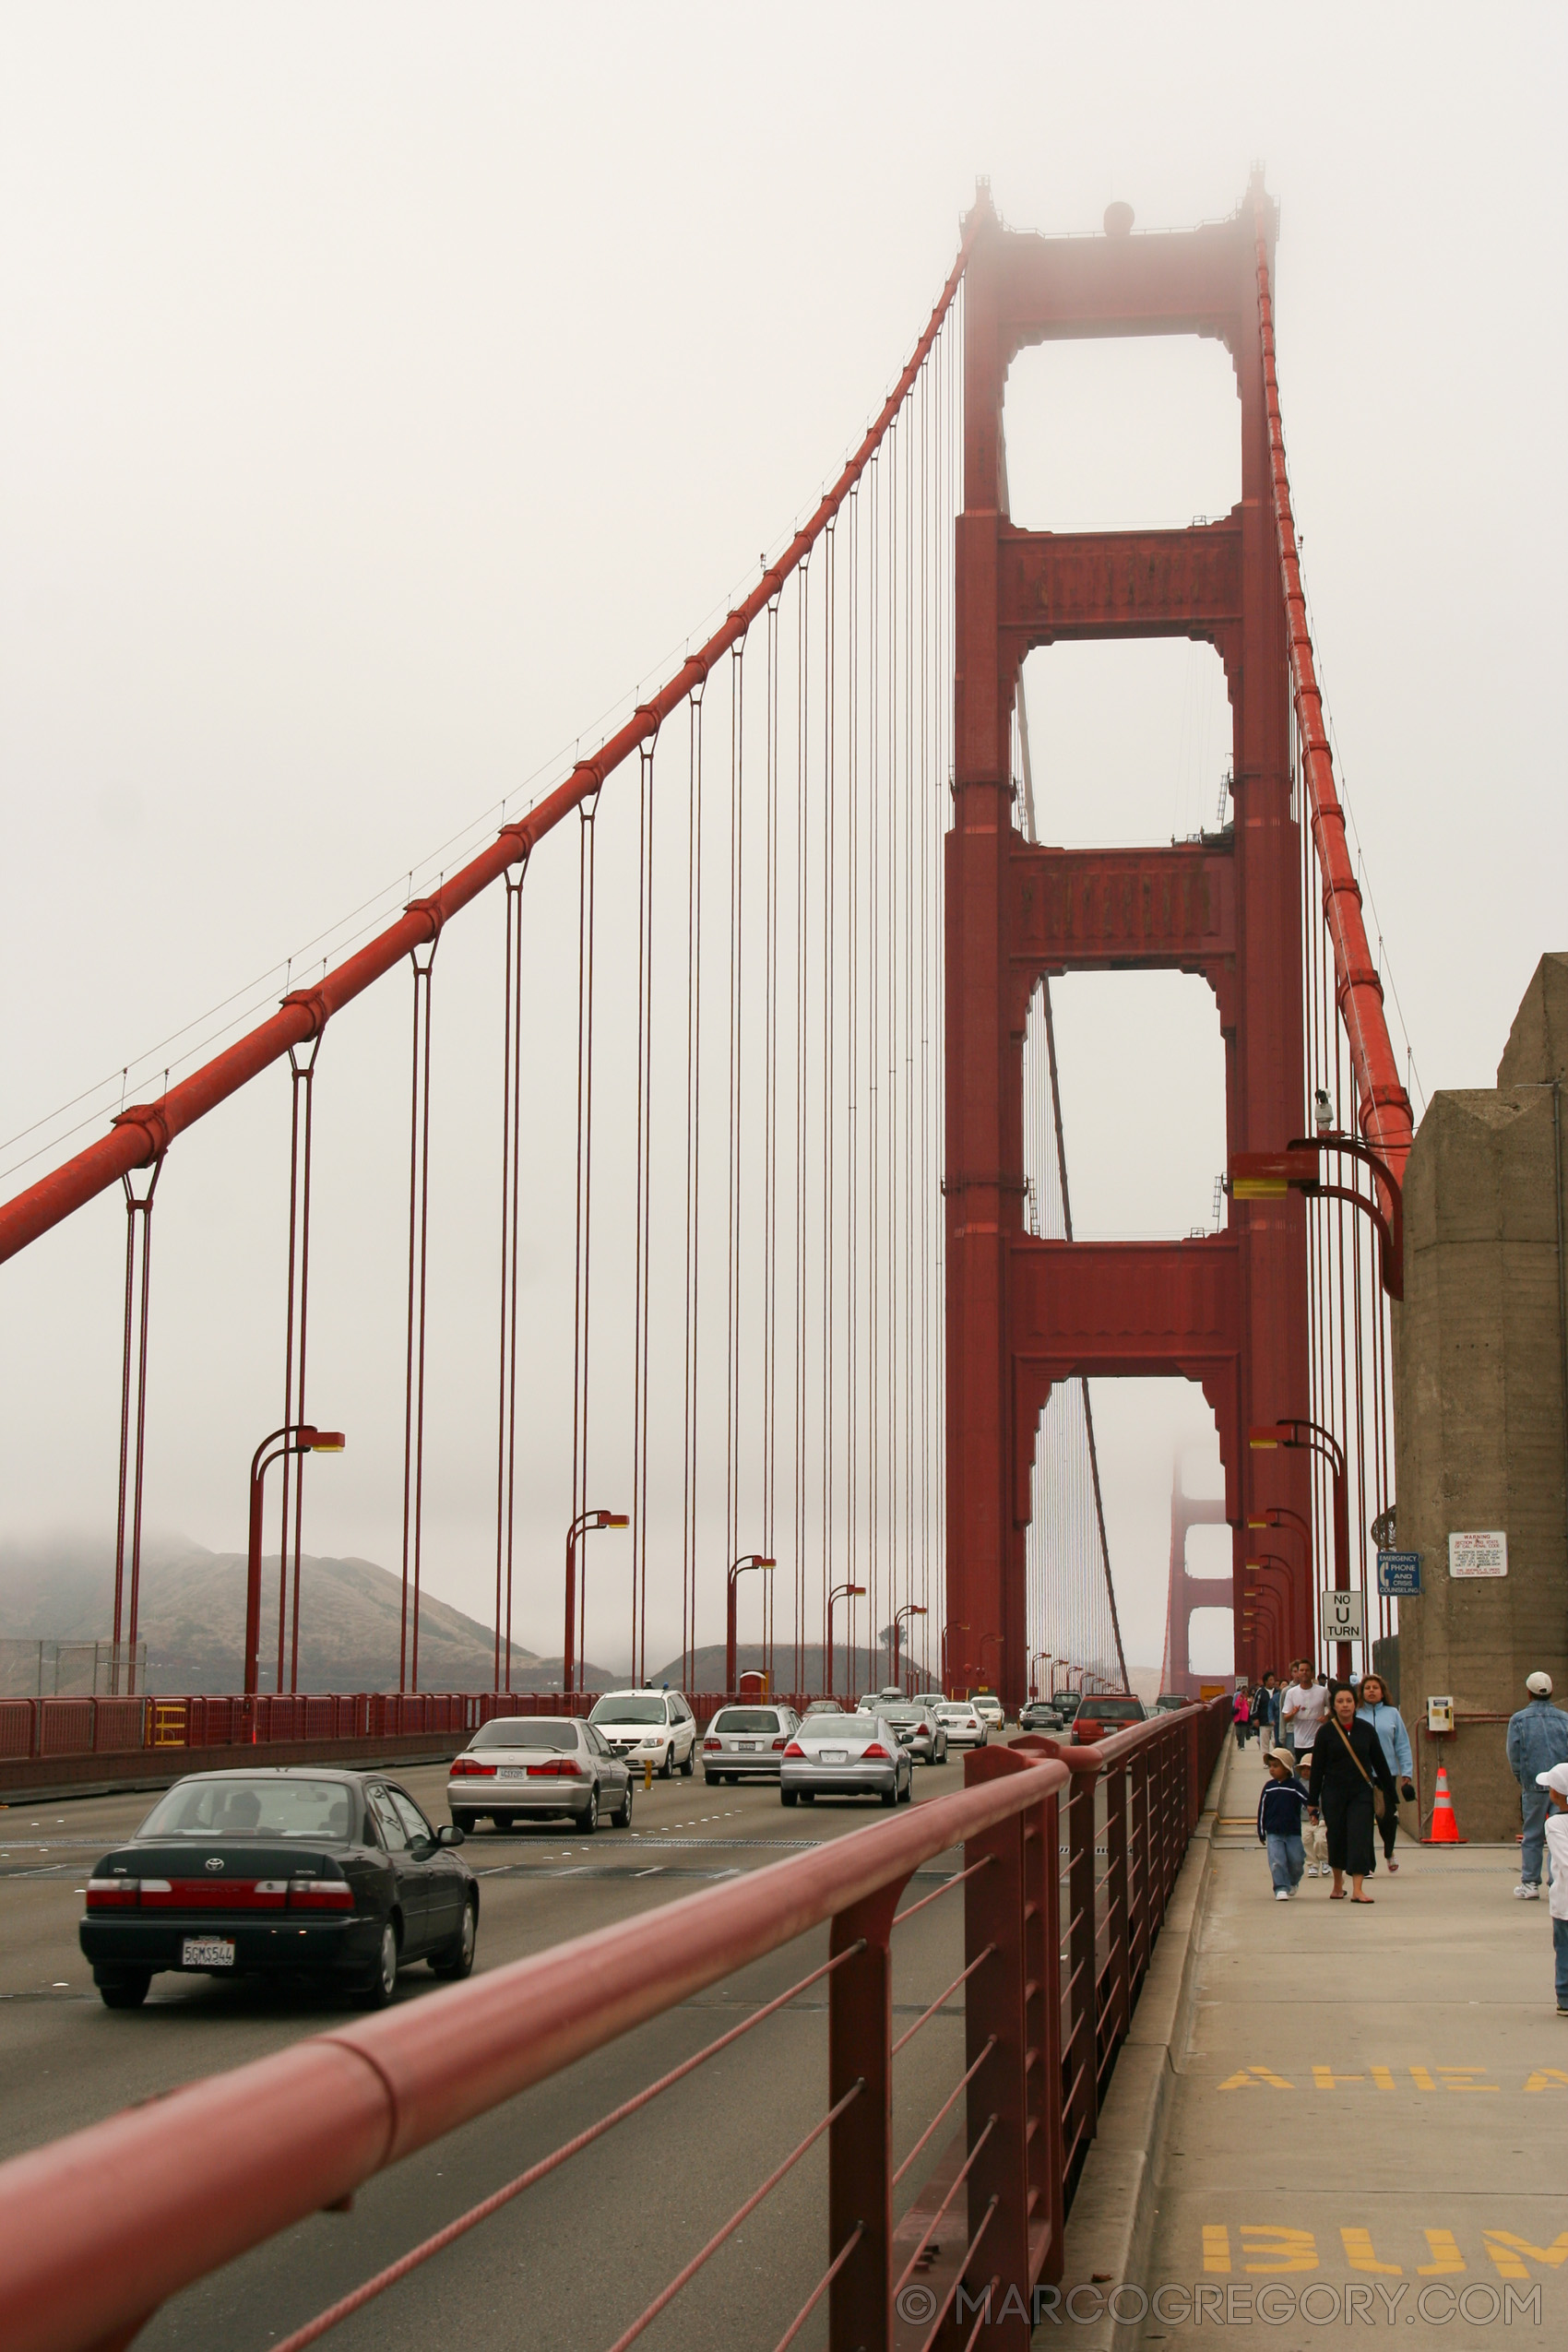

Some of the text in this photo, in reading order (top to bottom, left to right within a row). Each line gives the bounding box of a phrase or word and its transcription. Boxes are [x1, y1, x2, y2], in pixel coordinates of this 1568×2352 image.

[1334, 1595, 1350, 1605] NO
[1336, 1607, 1350, 1623] U
[1327, 1626, 1360, 1636] TURN
[184, 1946, 232, 1961] 5GMS544
